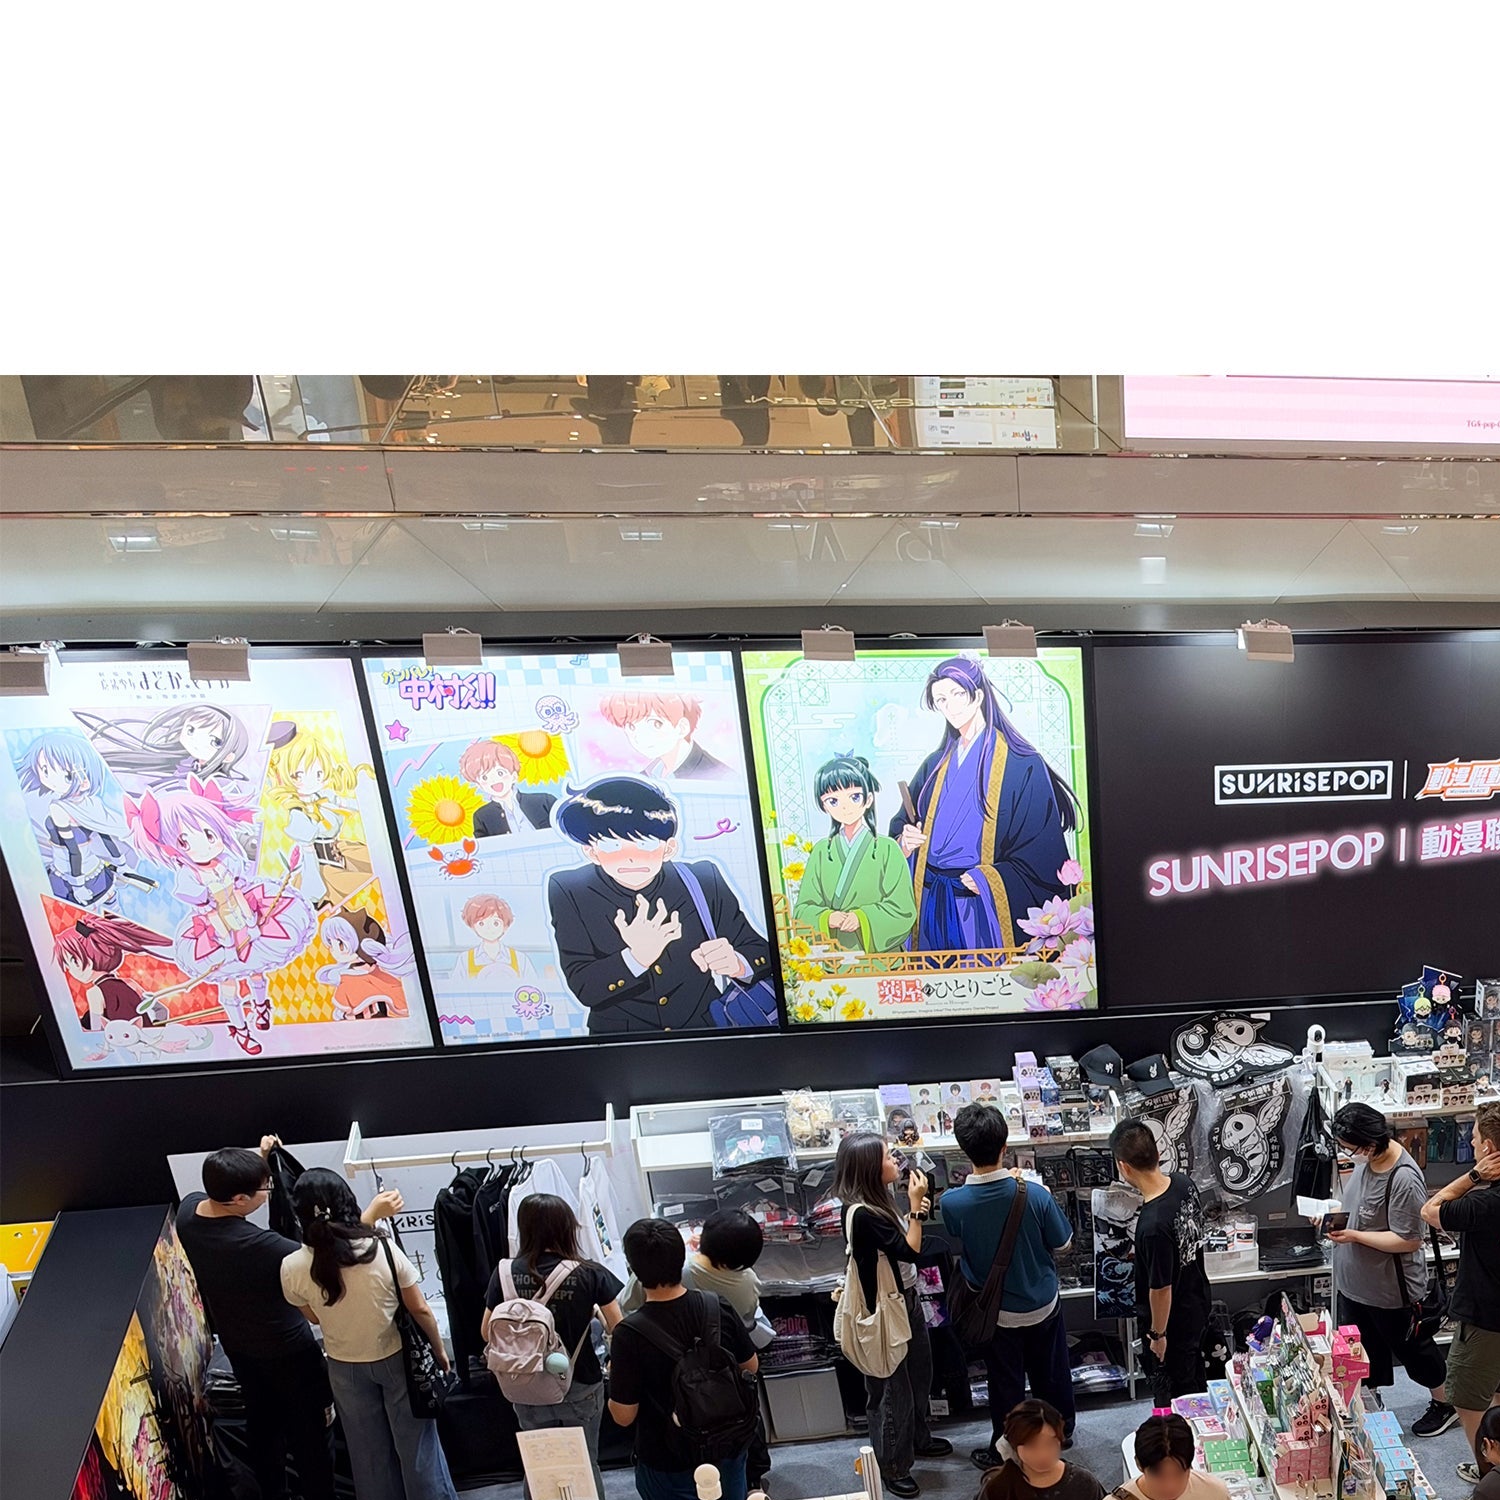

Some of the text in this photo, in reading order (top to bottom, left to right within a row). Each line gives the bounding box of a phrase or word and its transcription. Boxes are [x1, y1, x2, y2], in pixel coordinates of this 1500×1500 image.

[398, 672, 496, 711] 中村くん!!
[1148, 831, 1385, 897] SUNRISEPOP
[878, 973, 1013, 1005] 薬屋のひとりごと
